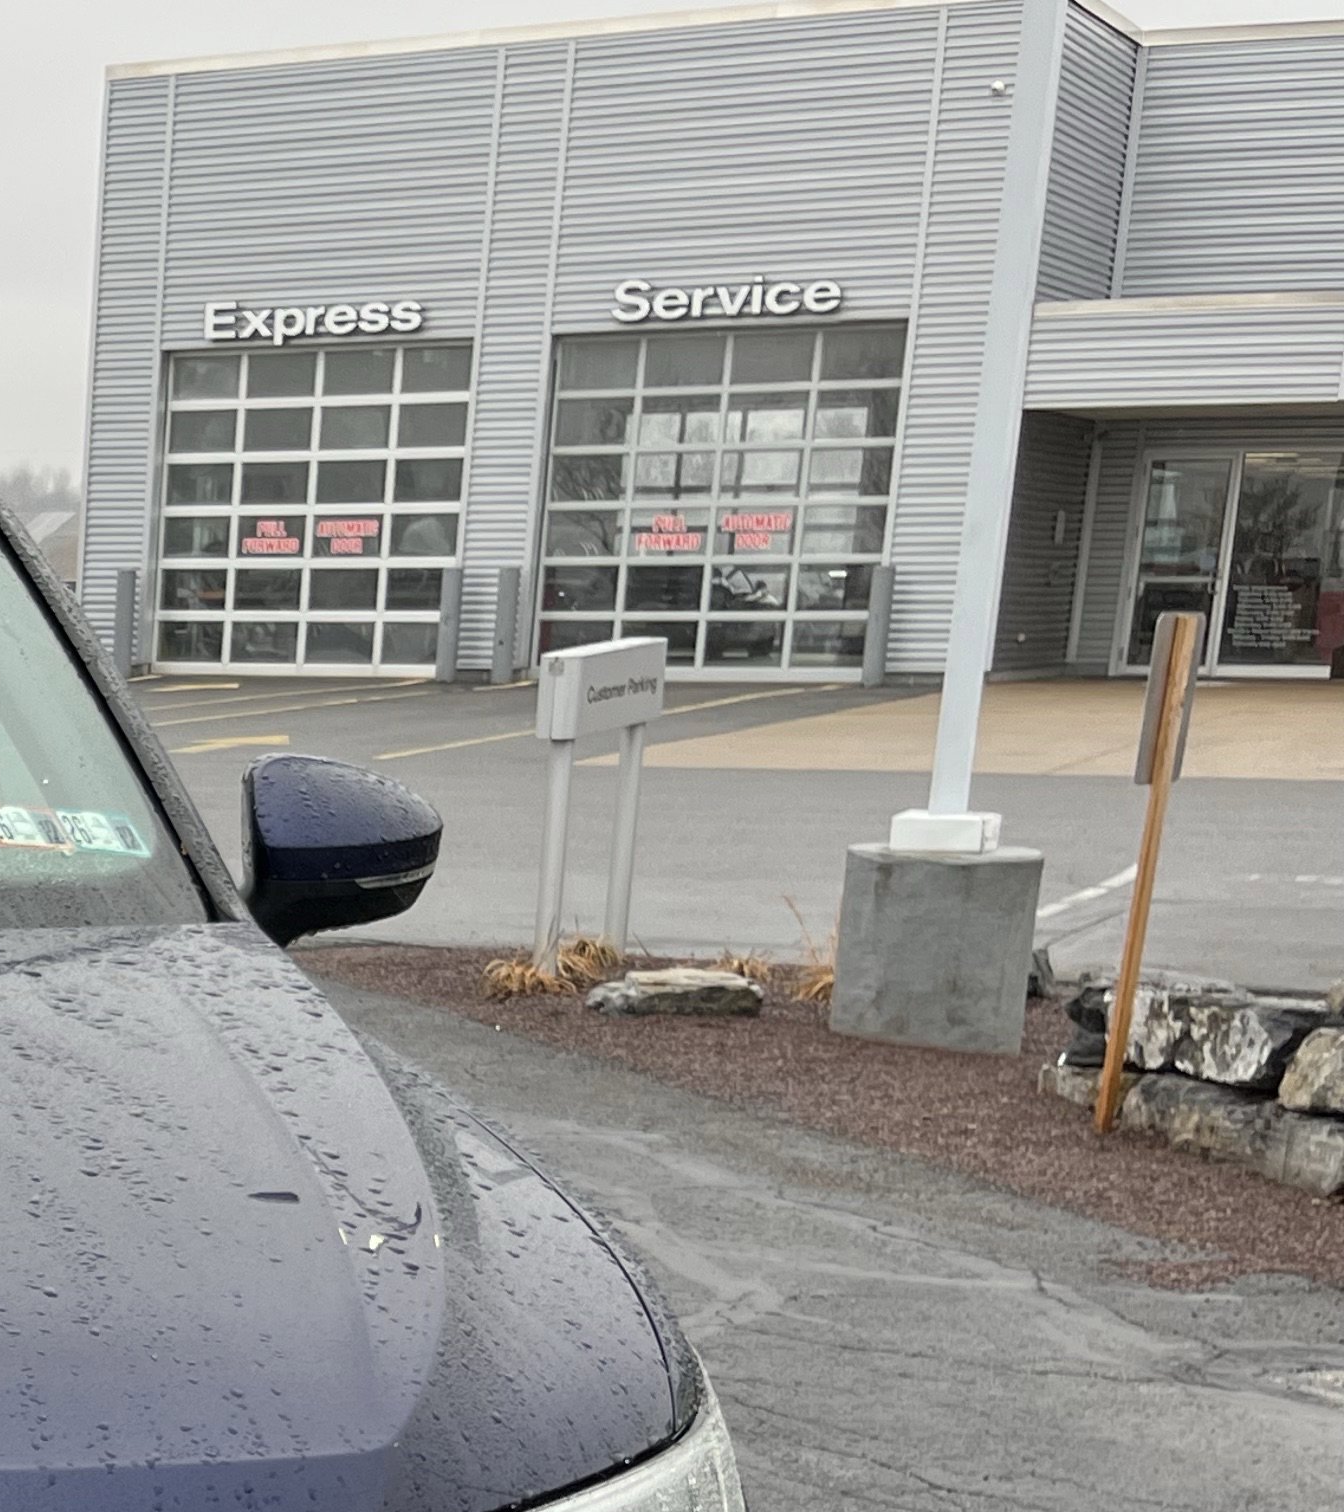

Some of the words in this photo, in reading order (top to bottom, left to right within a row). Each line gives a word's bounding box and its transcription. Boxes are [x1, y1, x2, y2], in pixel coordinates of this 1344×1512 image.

[612, 276, 842, 322] Service
[204, 301, 422, 346] Express
[256, 520, 287, 537] PULL
[652, 513, 687, 532] PULL
[241, 538, 300, 554] FORWARD
[635, 532, 702, 551] FORWARD
[587, 684, 626, 704] Customer
[627, 677, 657, 695] Parking
[63, 815, 93, 844] 26
